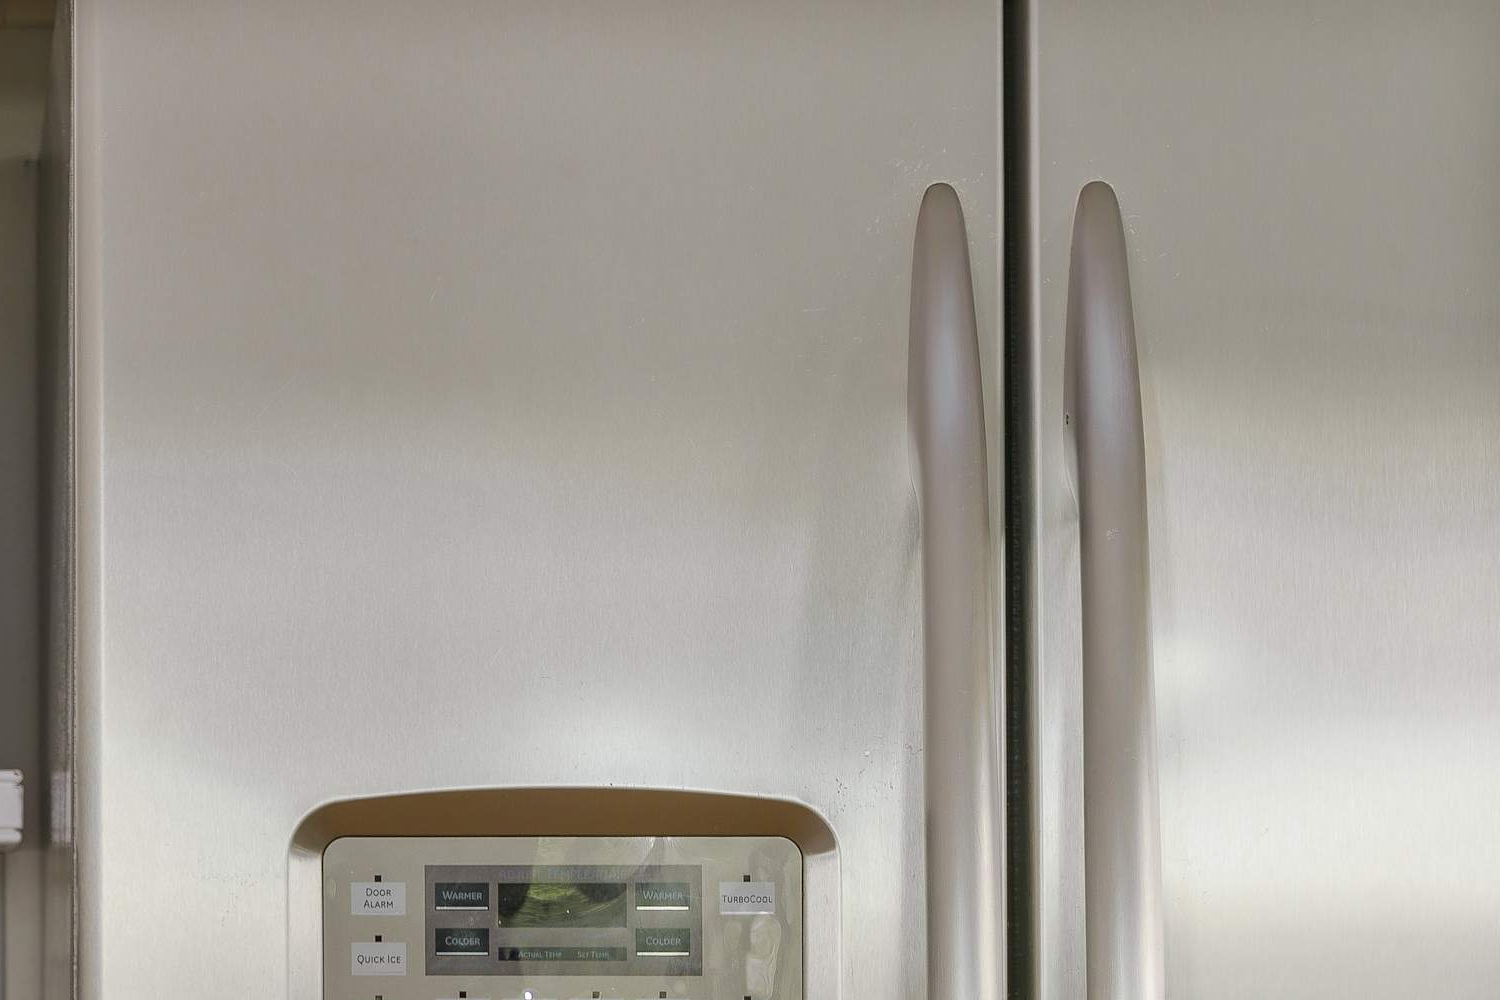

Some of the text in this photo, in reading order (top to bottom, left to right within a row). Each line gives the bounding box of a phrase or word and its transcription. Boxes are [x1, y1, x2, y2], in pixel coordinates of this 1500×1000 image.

[365, 887, 392, 897] DOOR
[442, 890, 483, 901] WARMER
[642, 890, 683, 901] WARMER
[363, 899, 394, 909] ALARM
[445, 935, 481, 946] COLDER
[645, 936, 681, 946] COLDER
[356, 953, 401, 965] QUICK ICE
